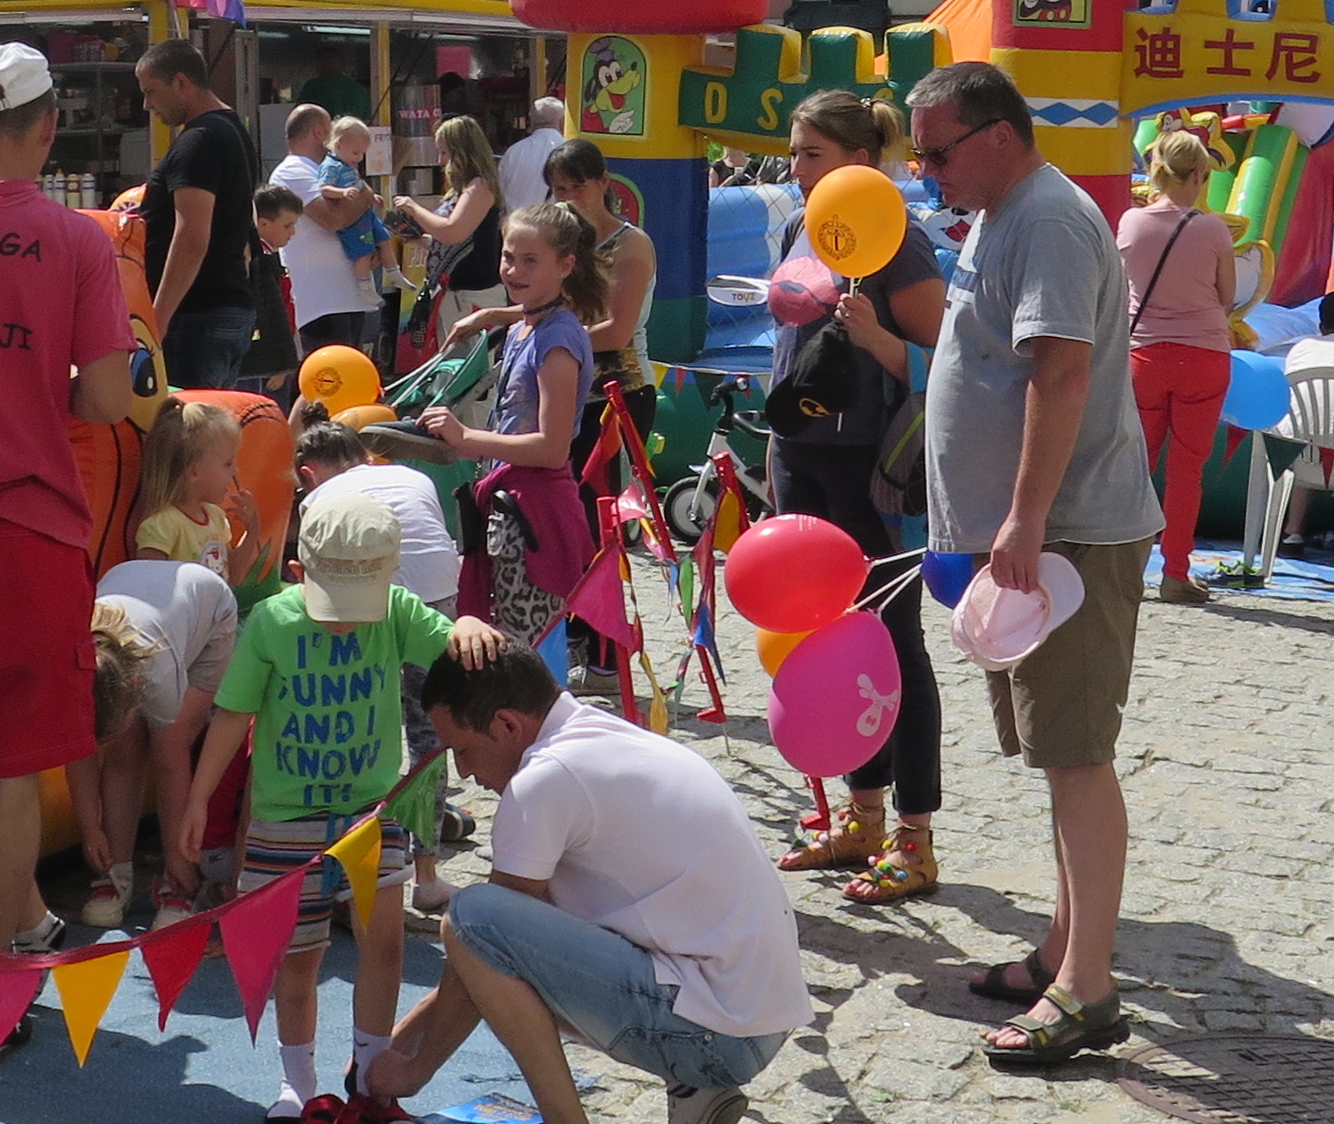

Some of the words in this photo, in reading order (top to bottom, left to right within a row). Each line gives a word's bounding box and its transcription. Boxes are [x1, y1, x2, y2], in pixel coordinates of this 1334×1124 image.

[297, 631, 363, 669] I'M
[281, 710, 355, 744] AND
[367, 705, 376, 736] I
[276, 739, 382, 780] KNOW
[303, 783, 353, 806] IT!
